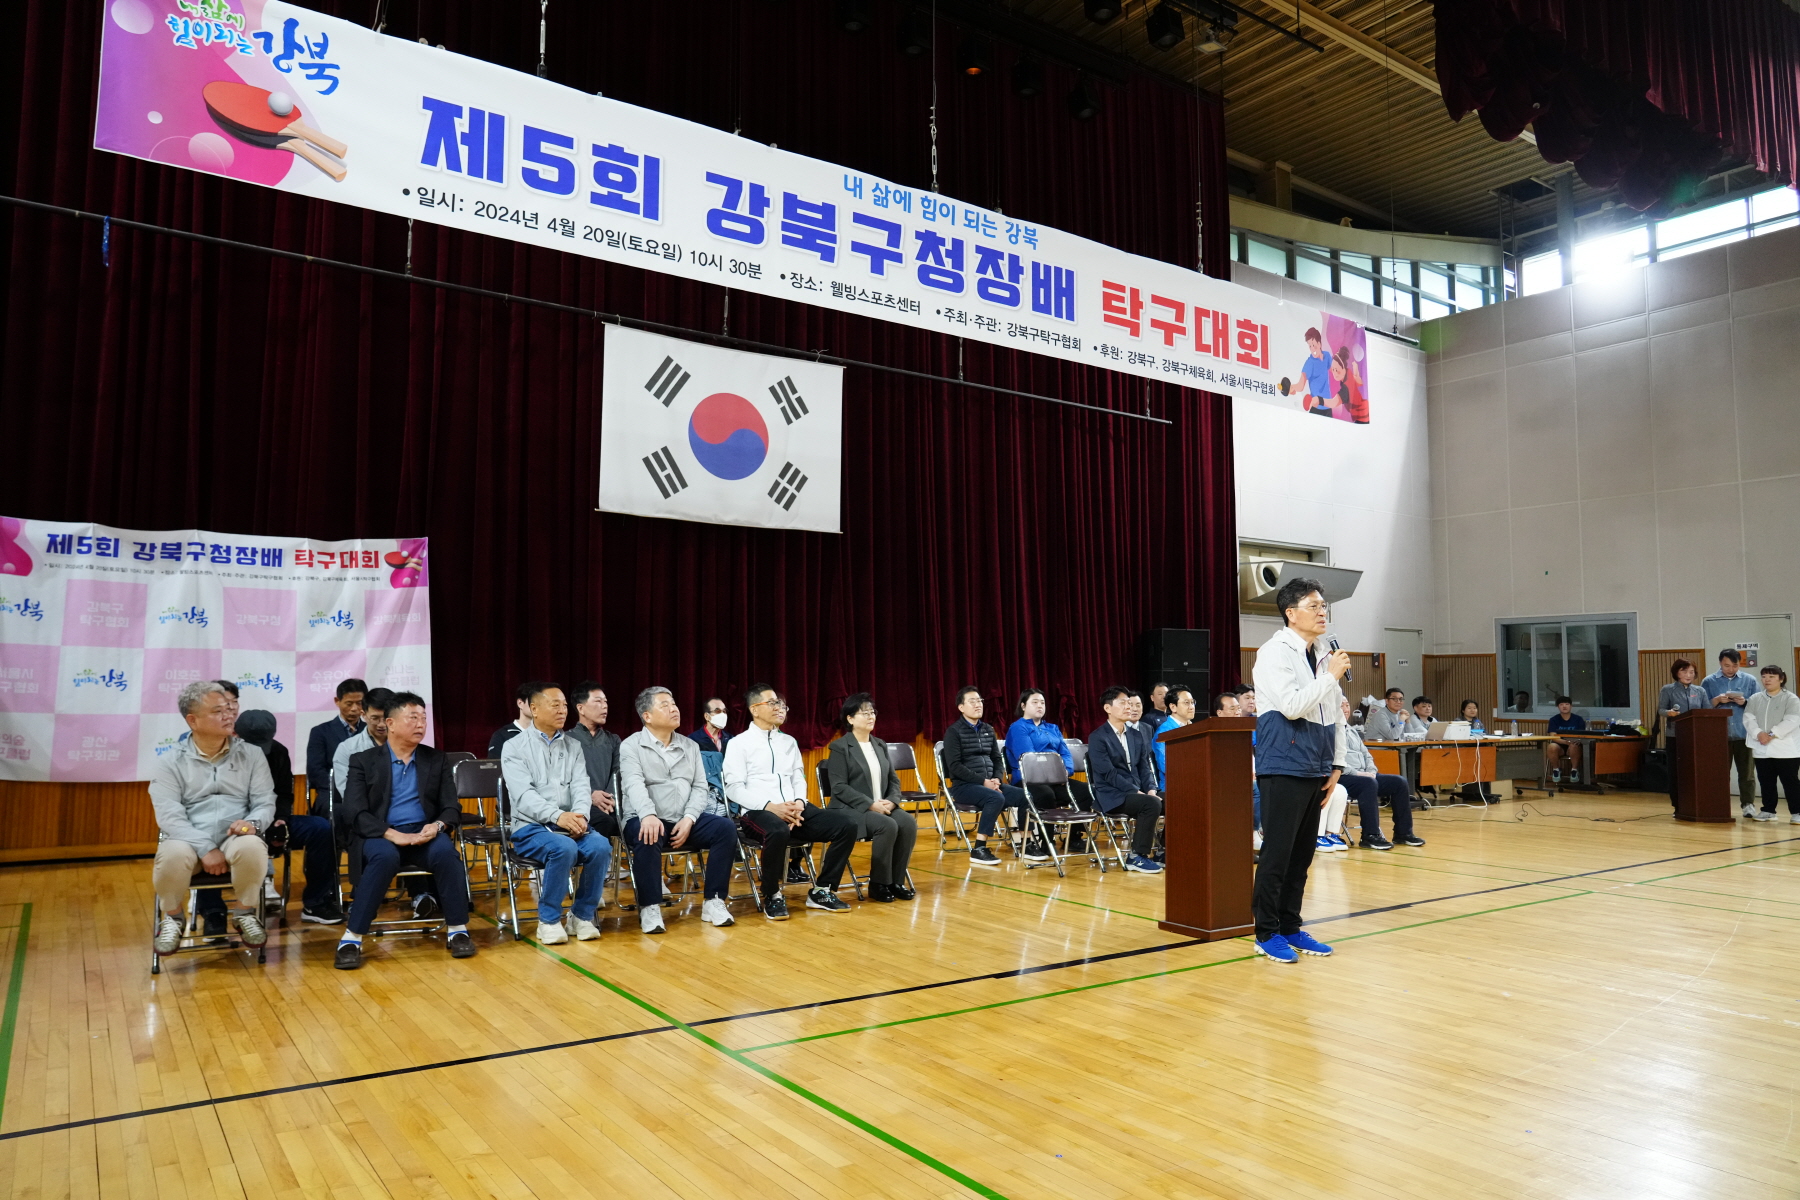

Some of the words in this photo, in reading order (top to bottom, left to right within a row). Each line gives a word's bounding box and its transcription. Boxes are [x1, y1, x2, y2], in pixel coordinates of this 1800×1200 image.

[253, 18, 341, 95] 강북
[844, 174, 862, 199] 내
[871, 182, 912, 213] 삶에
[920, 195, 956, 225] 힘이
[963, 209, 998, 238] 되는
[1005, 220, 1039, 250] 강북
[417, 186, 464, 212] 일시:
[474, 200, 539, 229] 2024년
[547, 217, 576, 238] 4월
[583, 225, 683, 262] 20일(토요일)
[690, 250, 723, 271] 10시
[729, 259, 762, 280] 30분
[420, 95, 661, 221] 제5회
[705, 171, 1075, 322] 강북구청장배
[1102, 279, 1269, 370] 탁구대회
[790, 271, 823, 292] 장소:
[830, 280, 921, 315] 웰빙스포츠센터
[1007, 322, 1082, 351] 강북구탁구협회
[1100, 343, 1123, 360] 후원:
[1128, 350, 1158, 370] 강북구,
[1220, 372, 1276, 397] 서울시탁구협회
[46, 533, 120, 558] 제5회
[133, 541, 283, 568] 강북구청장배
[294, 549, 380, 569] 탁구대회
[14, 598, 44, 621] 강북
[182, 606, 208, 628] 강북
[330, 609, 354, 630] 강북
[100, 669, 128, 691] 강북
[259, 672, 284, 693] 강북
